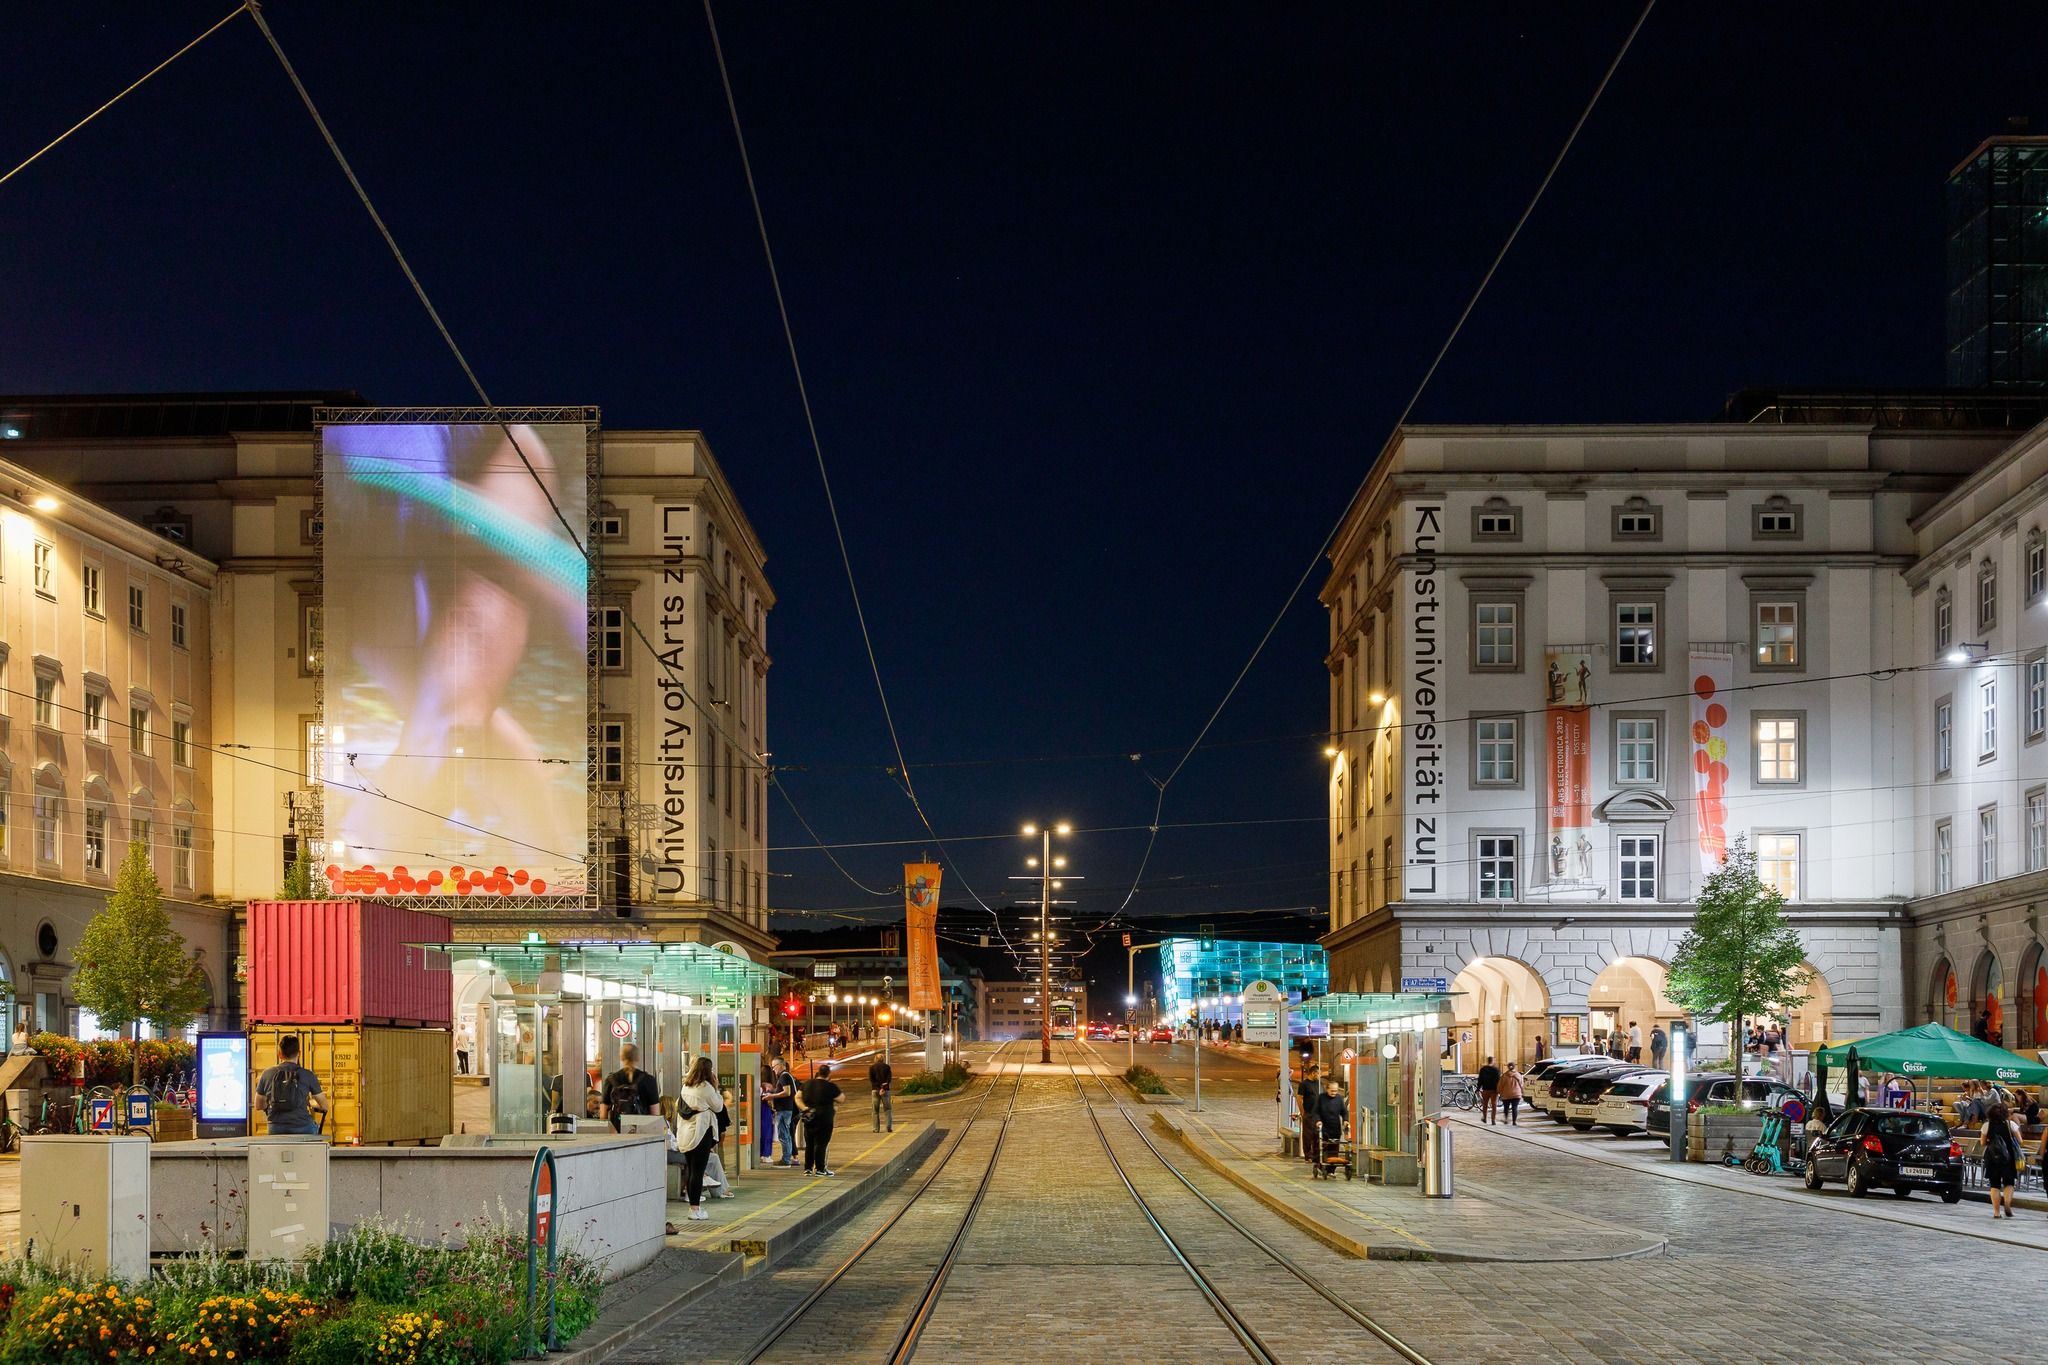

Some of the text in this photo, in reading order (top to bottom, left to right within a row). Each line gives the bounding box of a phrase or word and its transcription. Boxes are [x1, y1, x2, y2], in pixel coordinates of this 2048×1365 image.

[658, 506, 691, 895] University of Arts Linz
[1409, 506, 1444, 894] Kunstuniversität Linz
[1556, 716, 1565, 803] ARS ELECTRONICA 2023
[1902, 1061, 1927, 1073] Gösser
[1996, 1067, 2021, 1079] Gösser
[133, 1105, 146, 1114] Taxi
